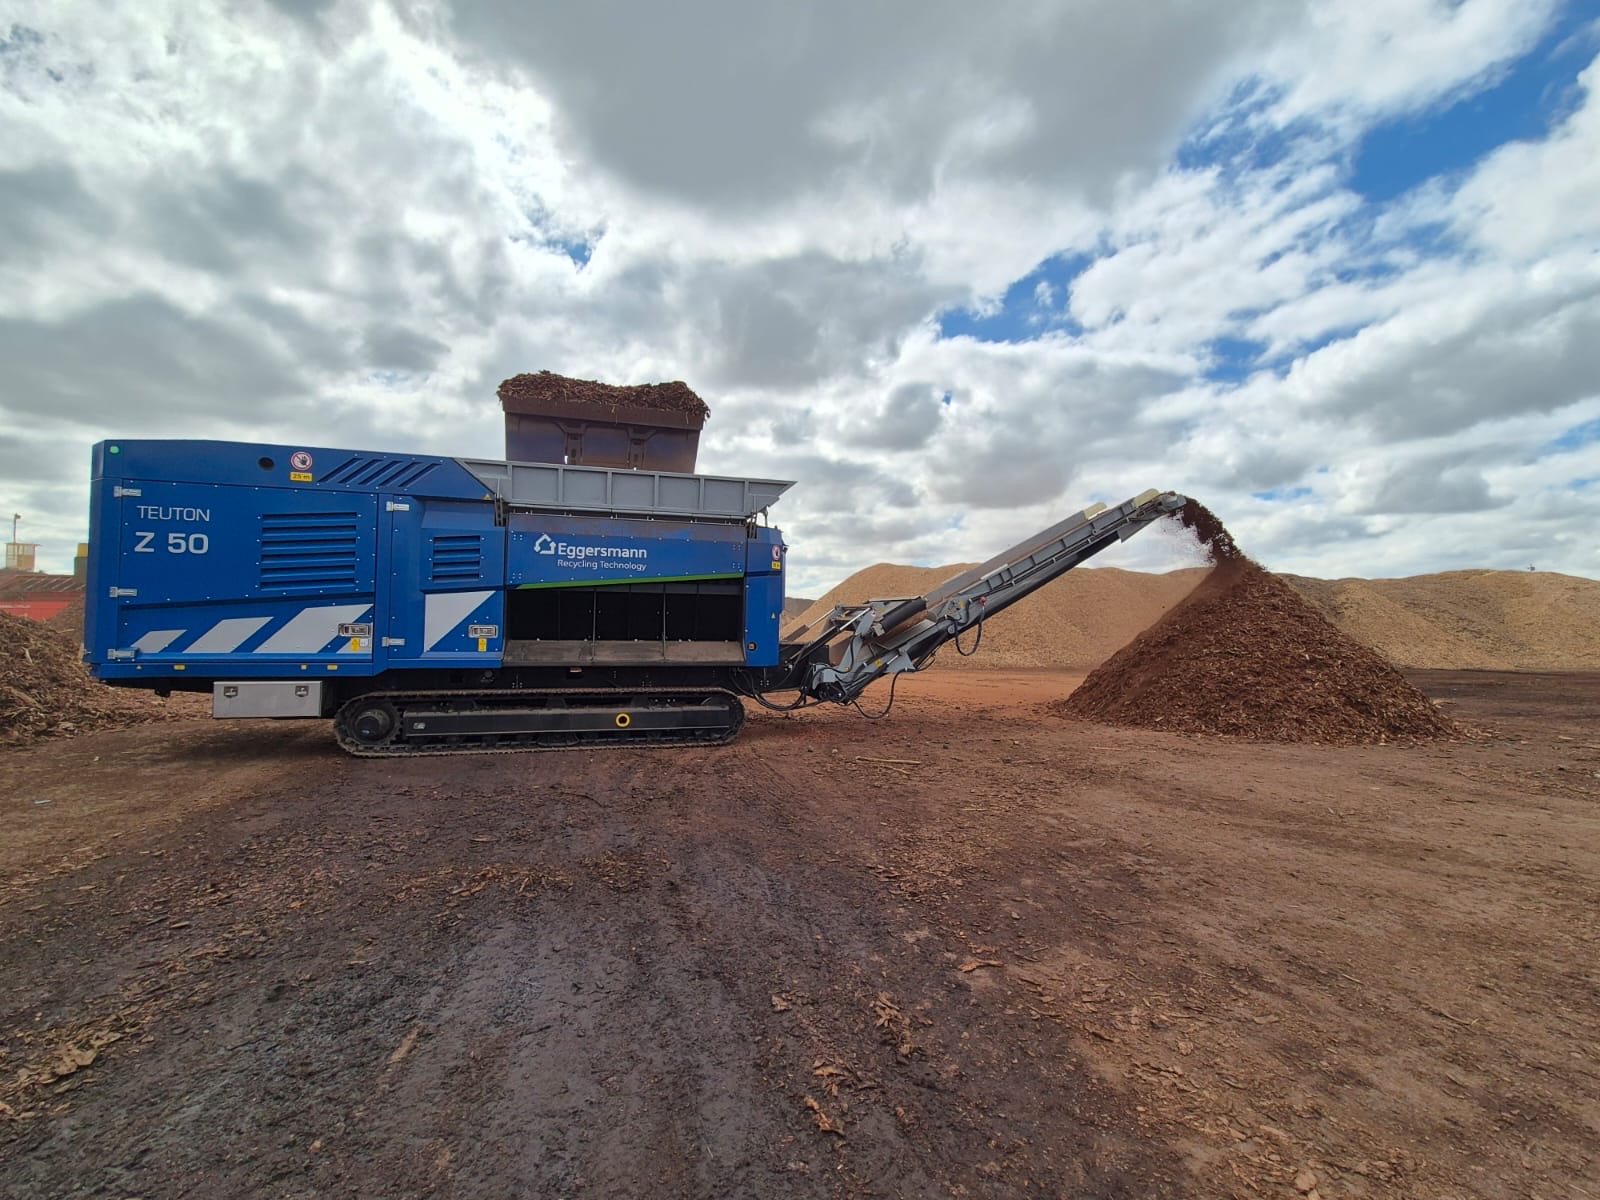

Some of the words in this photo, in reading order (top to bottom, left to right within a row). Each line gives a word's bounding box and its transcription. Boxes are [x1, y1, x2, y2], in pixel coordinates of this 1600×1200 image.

[136, 505, 210, 522] TEUTON
[134, 531, 155, 552] Z
[167, 533, 209, 554] 50
[557, 542, 647, 559] Eggersmann
[557, 559, 598, 570] Recycling
[600, 561, 647, 571] Technology
